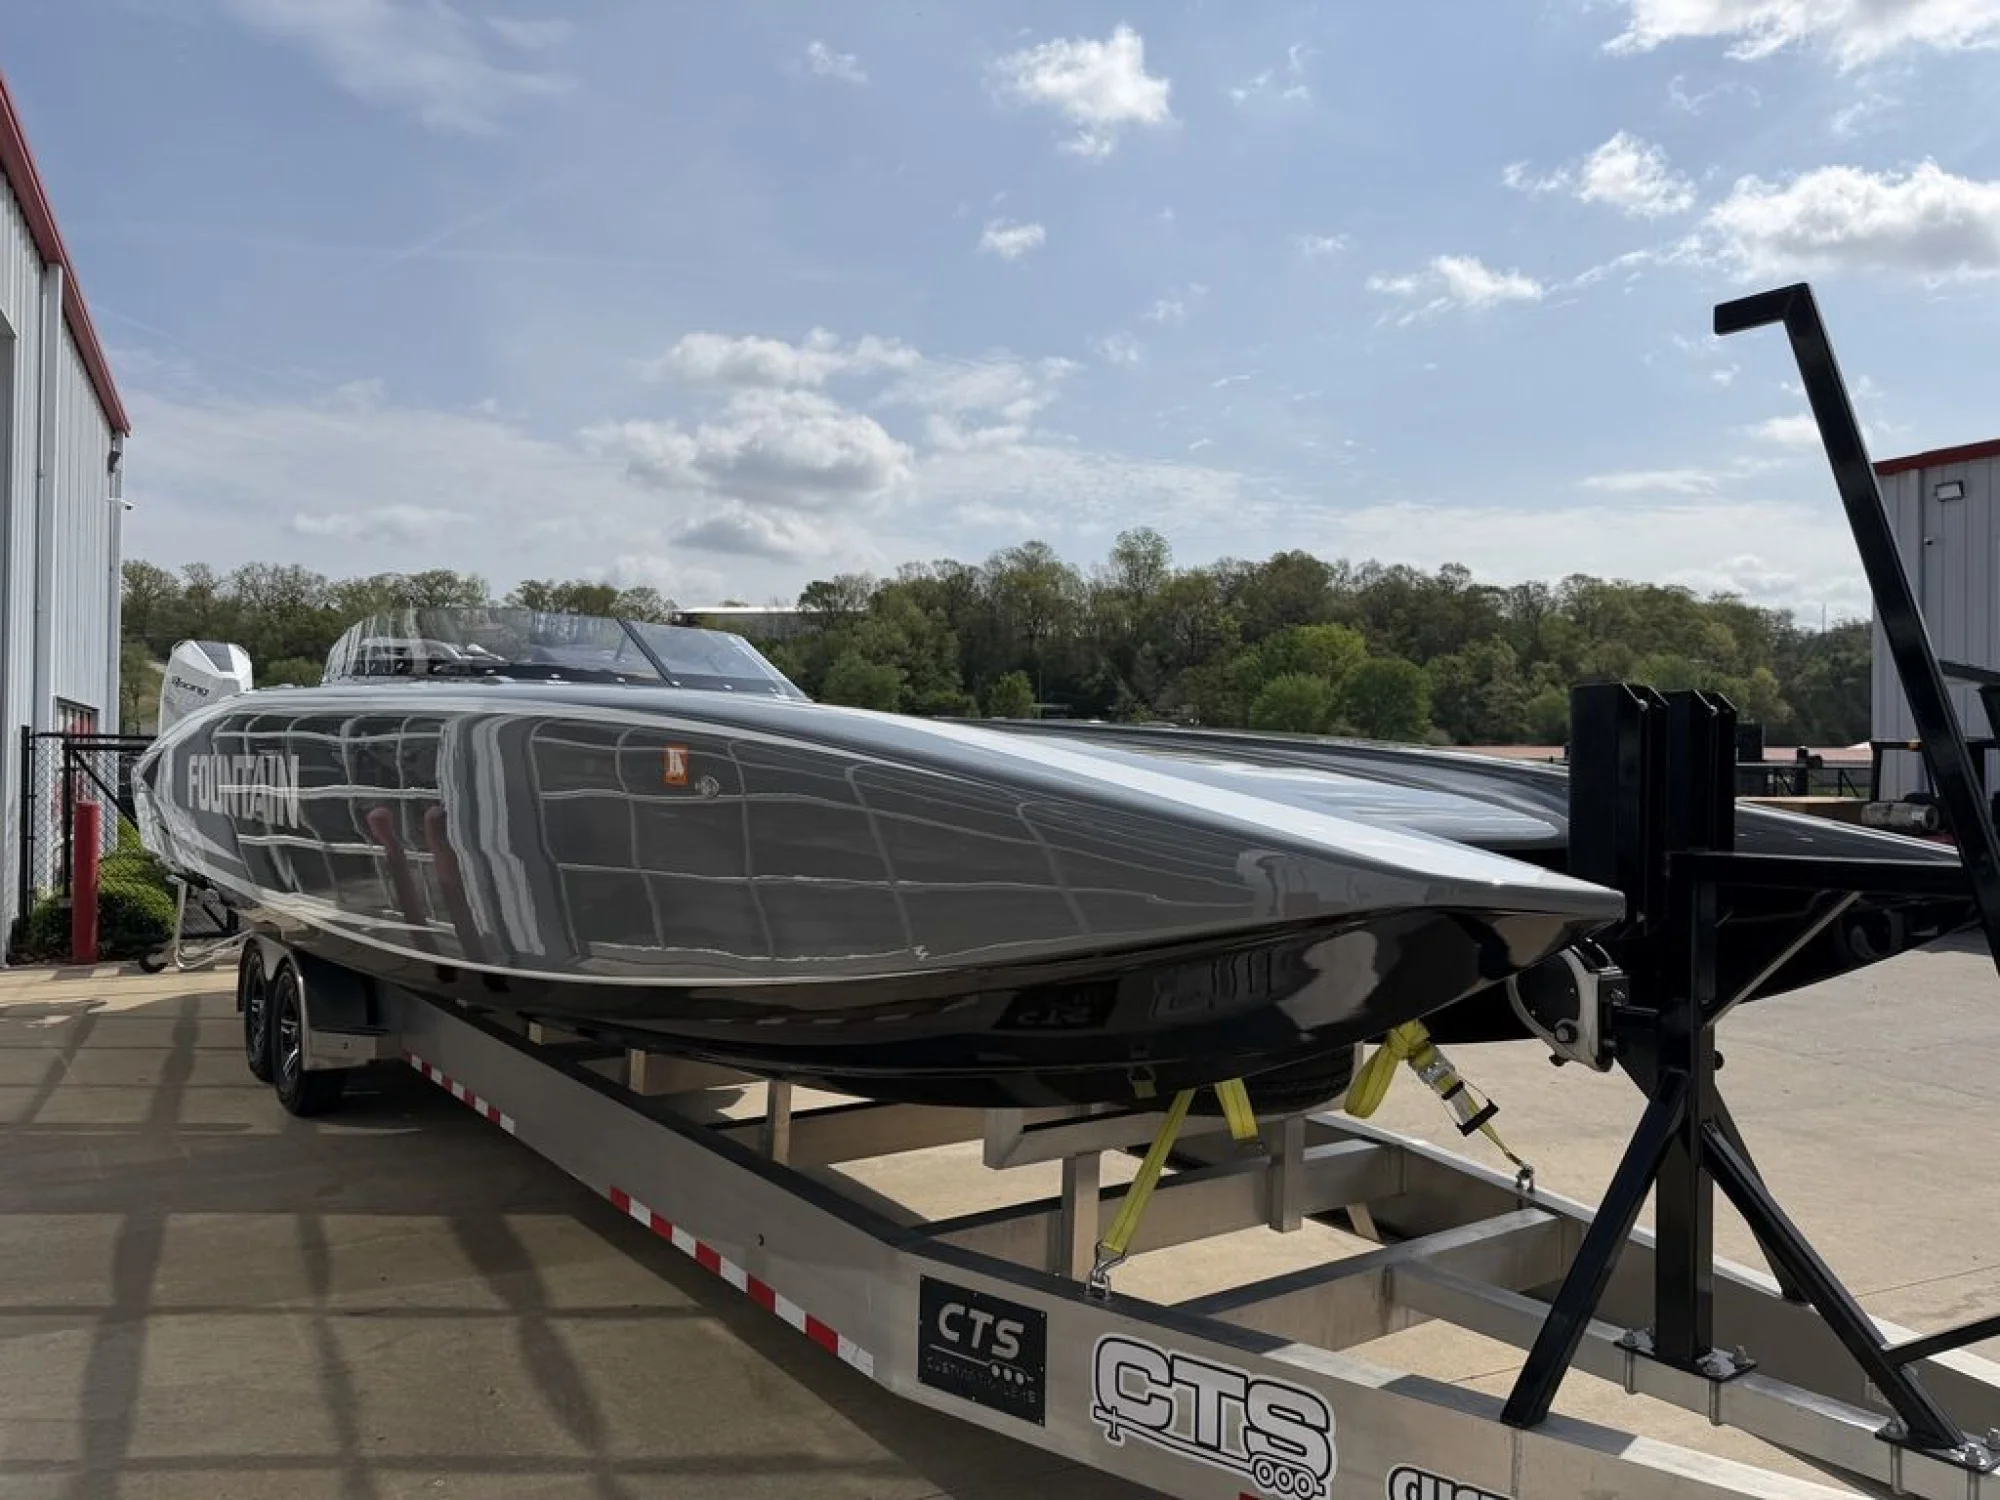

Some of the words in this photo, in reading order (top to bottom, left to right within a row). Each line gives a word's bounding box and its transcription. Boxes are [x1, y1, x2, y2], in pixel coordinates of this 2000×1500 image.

[188, 754, 299, 829] FOUNTAIN
[938, 1302, 1024, 1360] CTS
[1096, 1337, 1334, 1481] CTS
